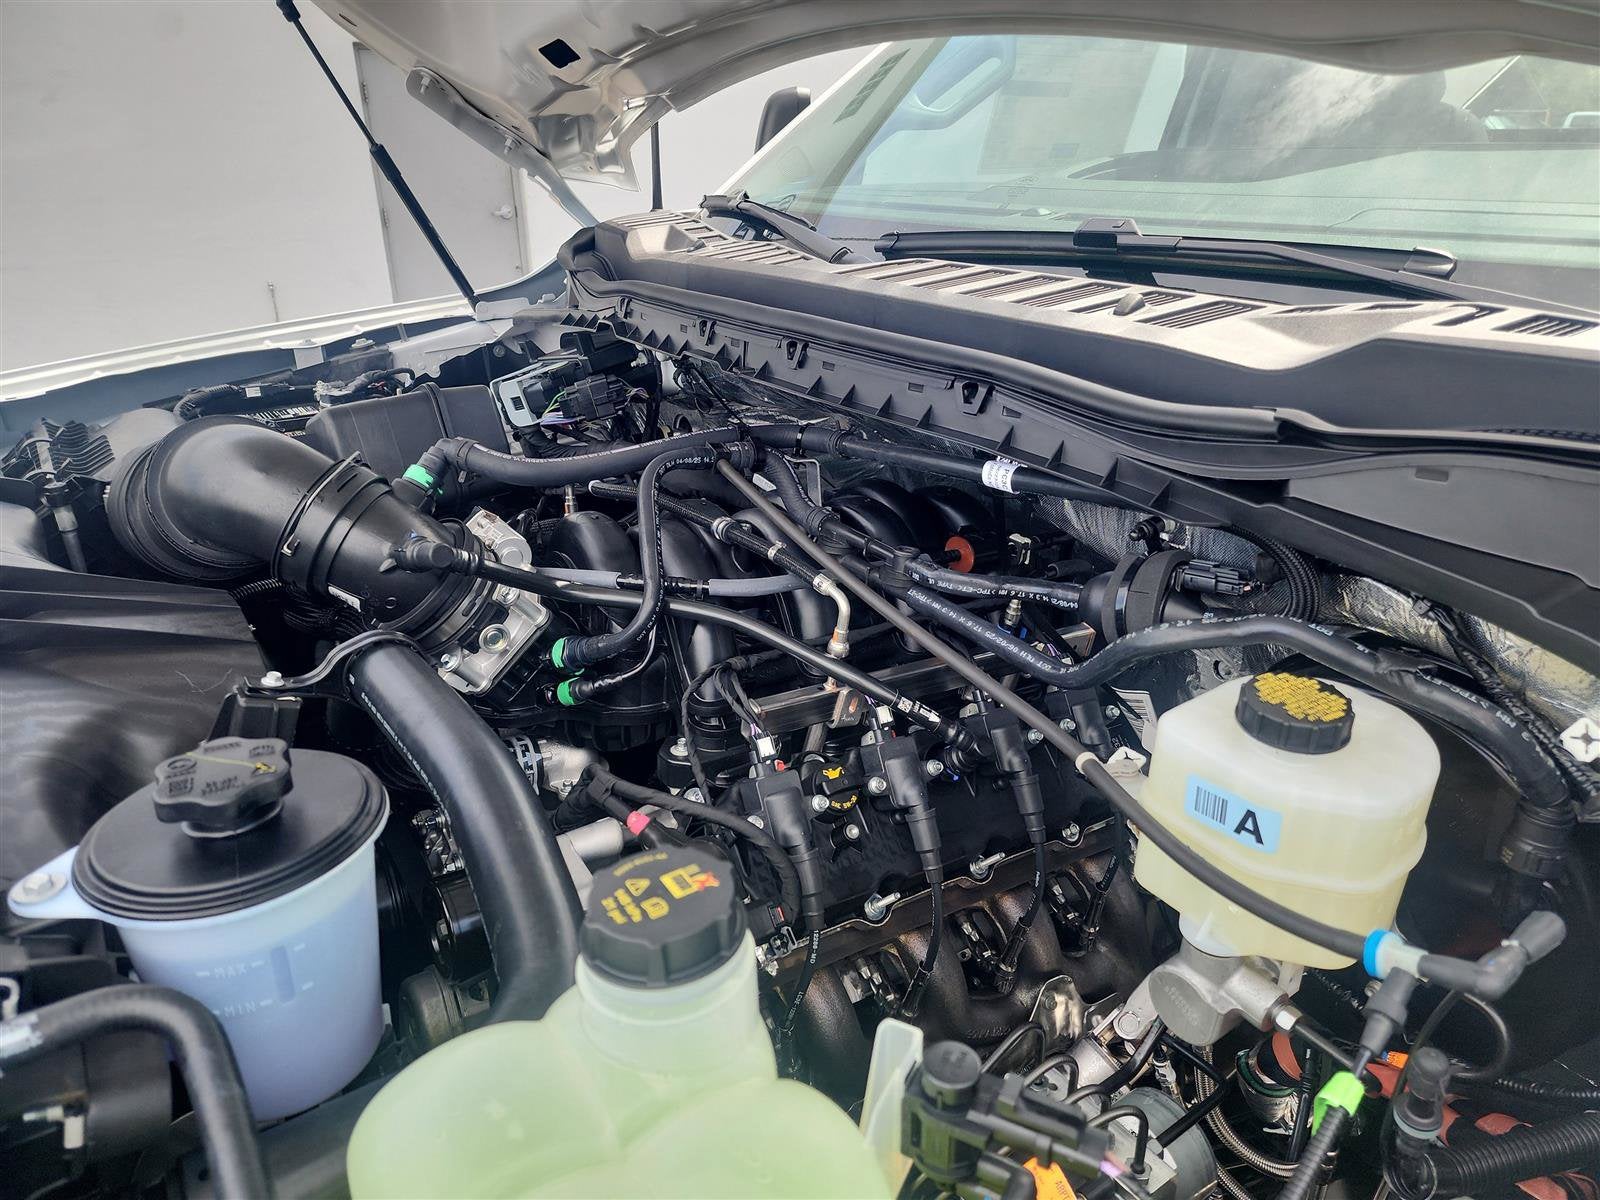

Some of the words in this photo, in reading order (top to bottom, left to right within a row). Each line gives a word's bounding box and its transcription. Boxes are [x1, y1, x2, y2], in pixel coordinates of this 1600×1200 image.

[1233, 809, 1264, 846] A
[214, 962, 248, 978] MAX
[223, 1000, 256, 1017] MIN
